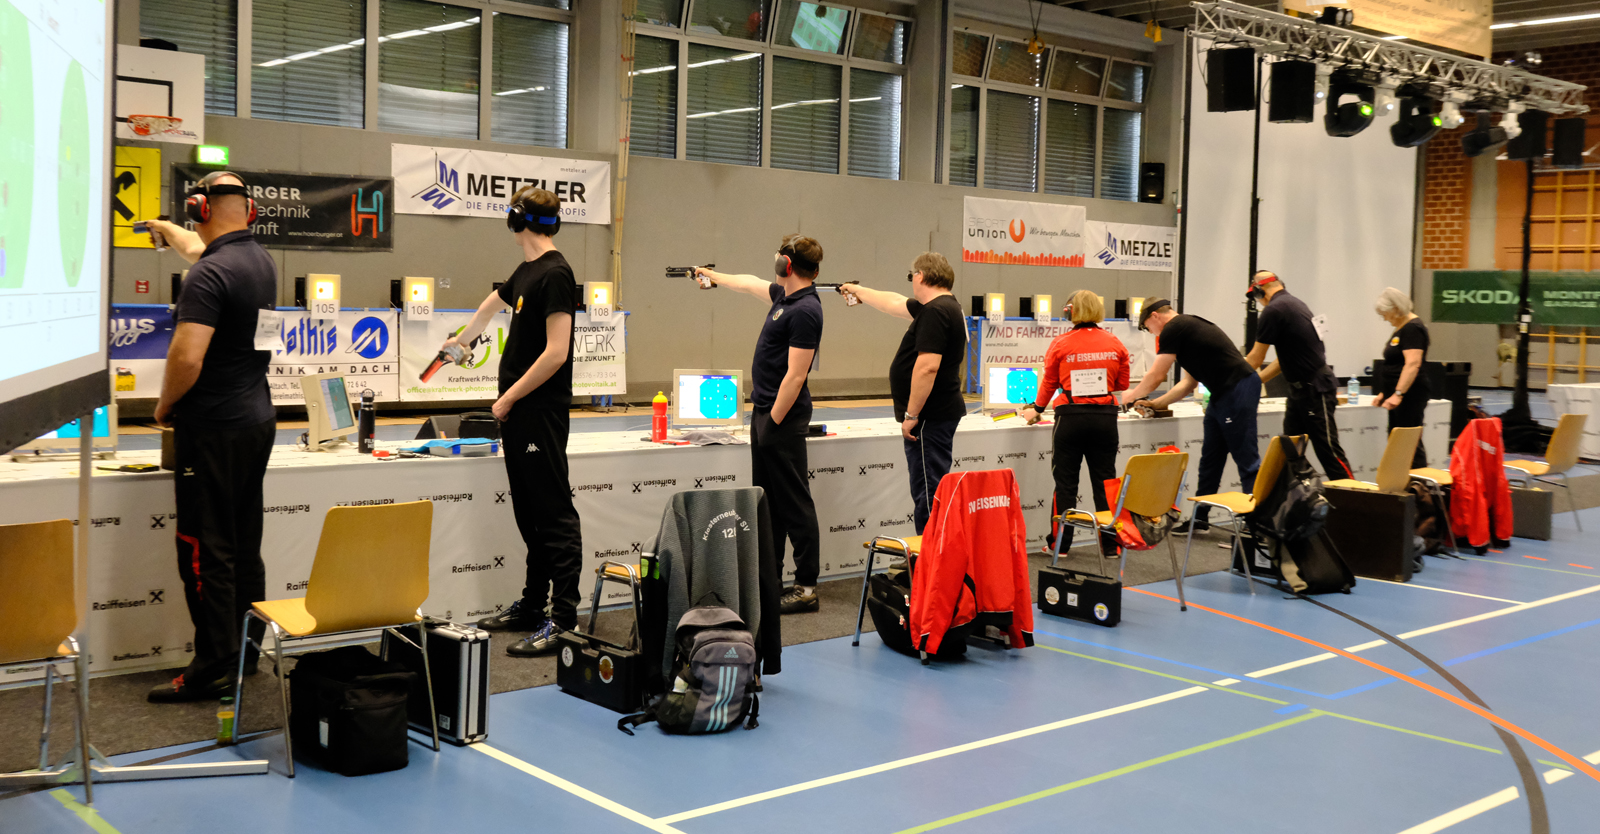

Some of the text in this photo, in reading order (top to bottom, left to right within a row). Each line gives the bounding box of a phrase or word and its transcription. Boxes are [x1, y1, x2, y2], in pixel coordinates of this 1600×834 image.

[466, 202, 482, 210] DIE
[1120, 239, 1173, 258] METZLE
[1130, 260, 1172, 268] FERTIGUNGSPRO
[1441, 290, 1520, 304] SKOD
[315, 303, 335, 313] 105
[411, 305, 430, 315] 106
[593, 307, 610, 317] 108
[991, 314, 1002, 322] 201
[1066, 354, 1076, 364] SV
[350, 365, 391, 374] DACH
[407, 385, 498, 394] office@kraftwerk-photovolt
[817, 466, 844, 474] Raiffeisen
[868, 463, 894, 472] Raiffeisen
[643, 478, 676, 488] Raiffeisen
[705, 475, 736, 484] Raiffeisen
[578, 484, 612, 493] Raiffeisen
[432, 493, 473, 503] Raiffeisen
[261, 503, 310, 515] Raiffeisen
[740, 520, 751, 532] SV
[829, 525, 856, 533] Raiffeisen
[595, 550, 629, 559] Raiffeisen
[452, 564, 490, 574] Raiffeisen
[286, 582, 309, 592] Raiff
[92, 599, 146, 611] Raiffeisen
[113, 653, 150, 662] Raiffeisen
